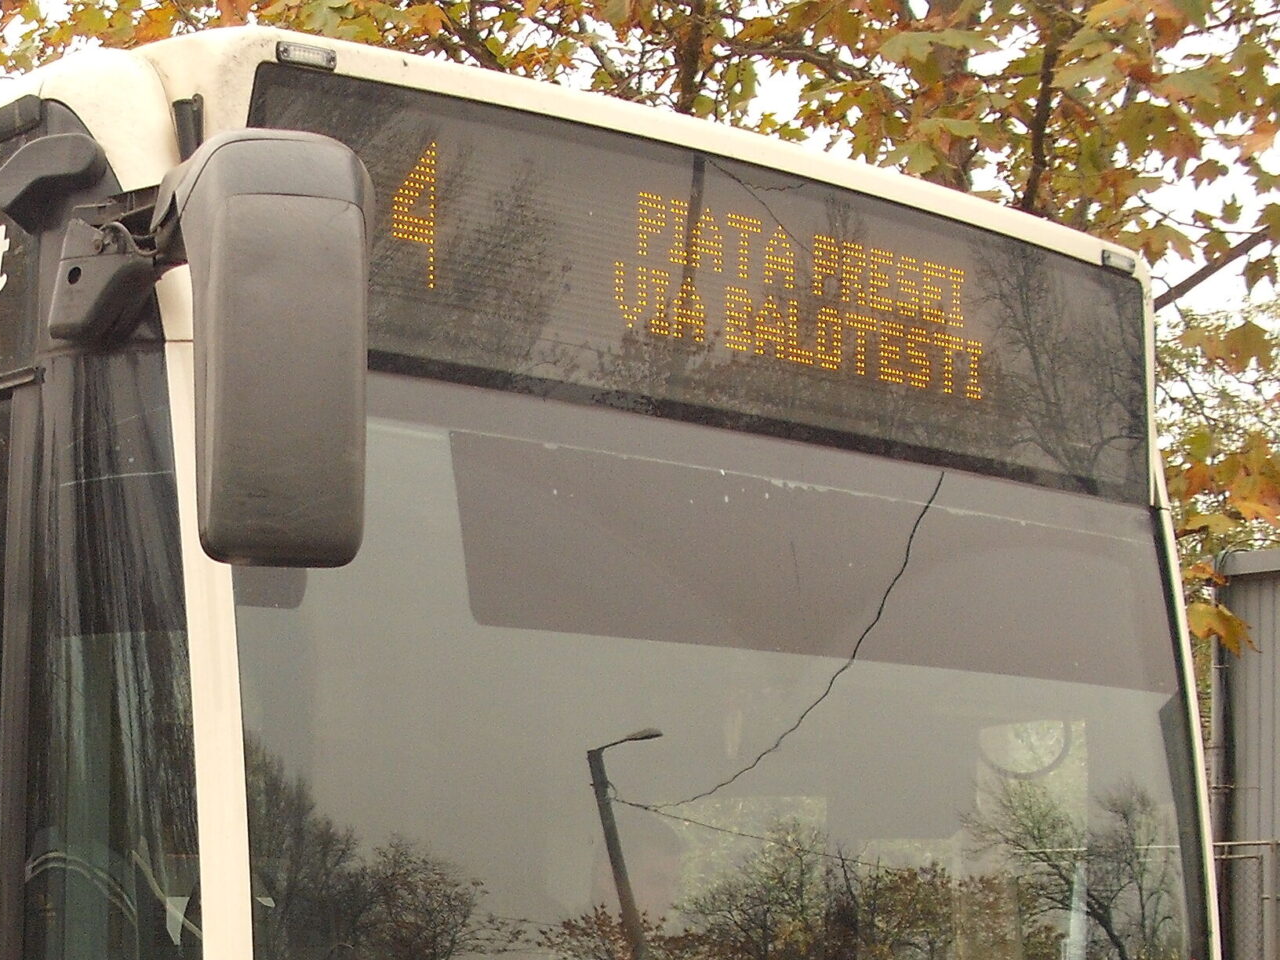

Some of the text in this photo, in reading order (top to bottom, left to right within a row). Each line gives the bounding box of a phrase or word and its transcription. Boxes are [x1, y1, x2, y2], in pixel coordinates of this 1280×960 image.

[391, 140, 437, 289] 4
[637, 190, 966, 328] PIATA PRESEI
[613, 260, 984, 400] VIA BALOTESTI
